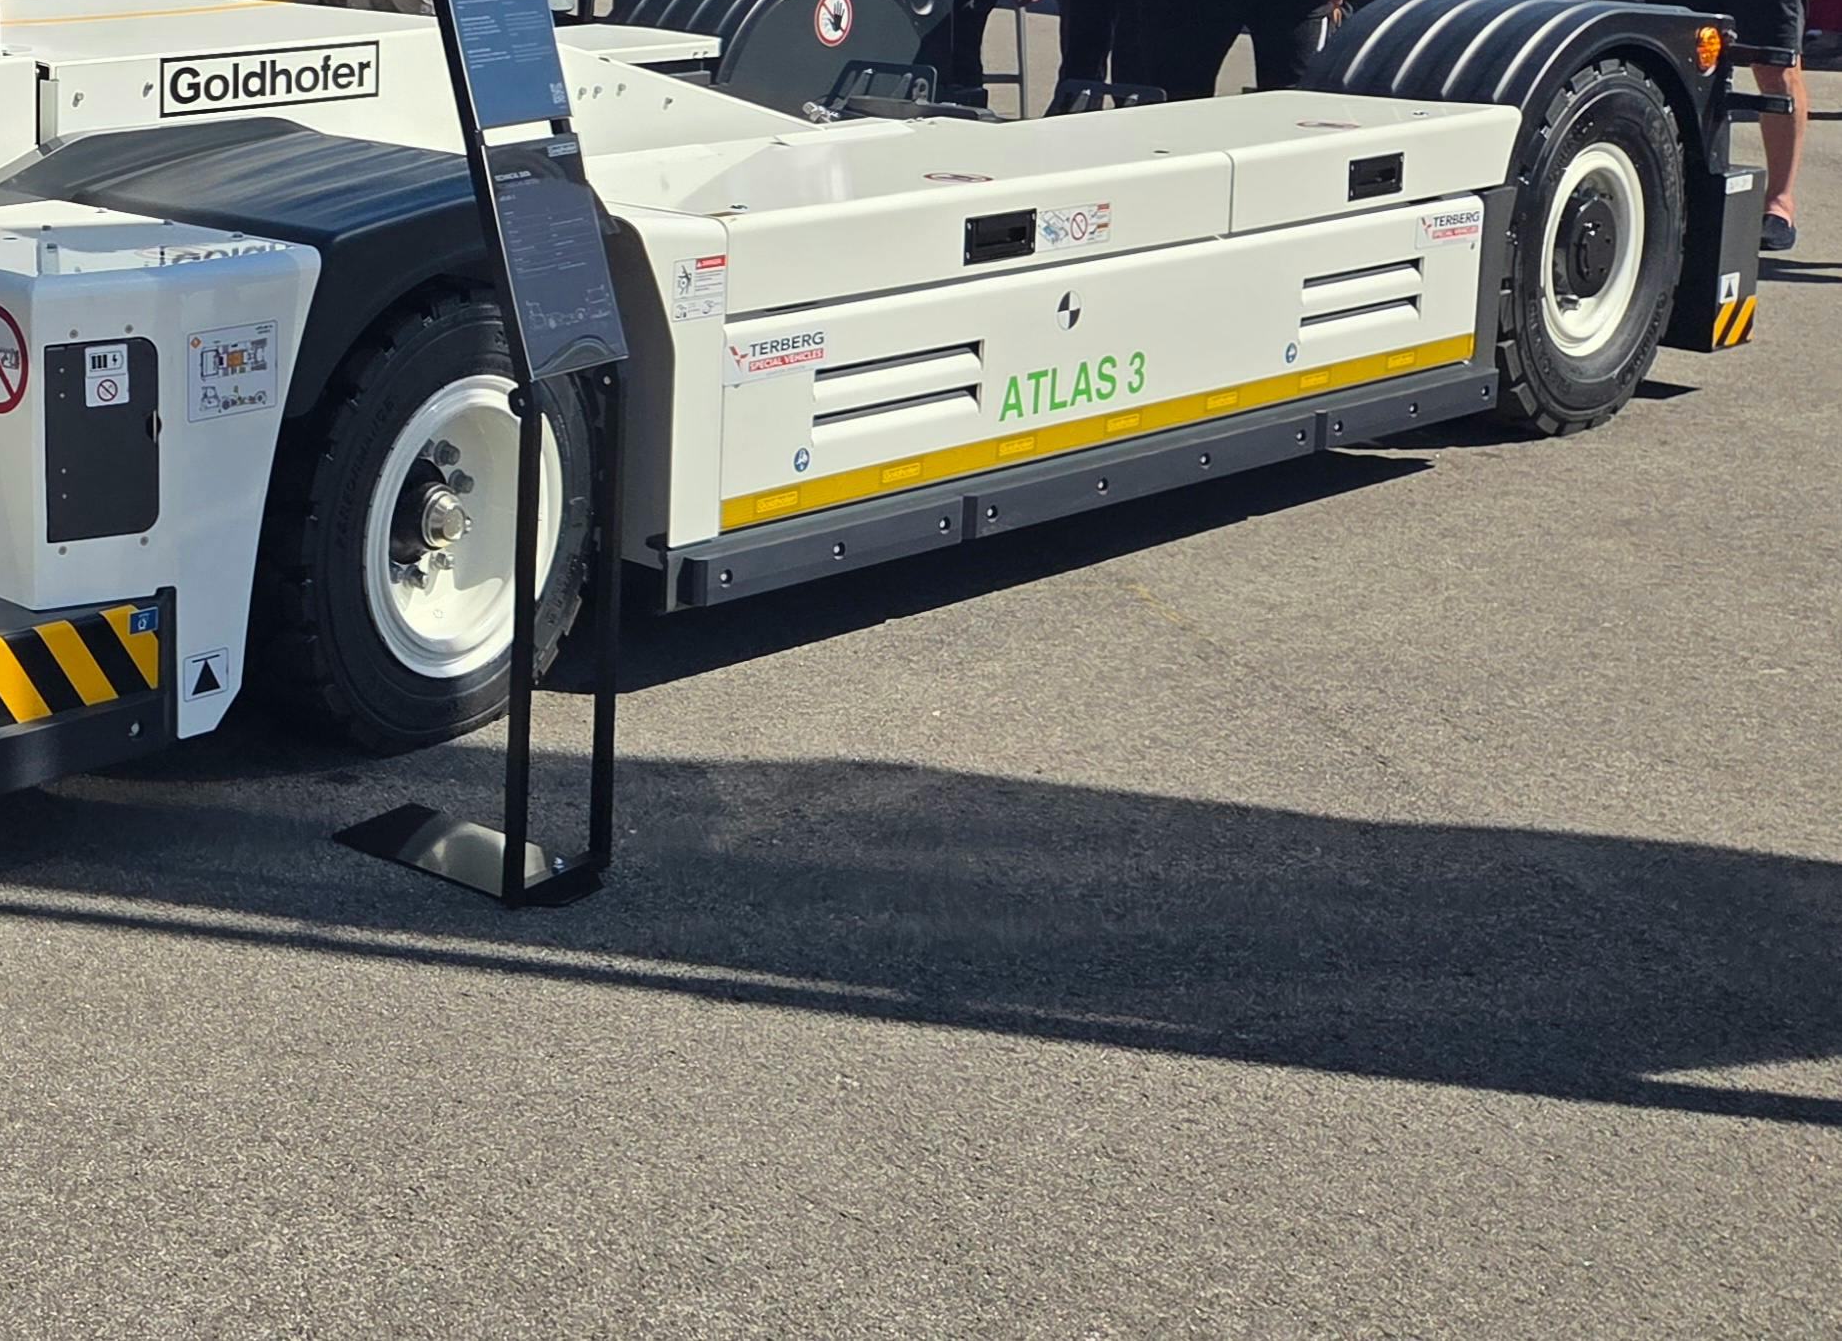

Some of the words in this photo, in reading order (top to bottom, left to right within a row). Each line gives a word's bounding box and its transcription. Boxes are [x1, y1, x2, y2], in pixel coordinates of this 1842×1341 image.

[169, 55, 372, 105] Goldhofer
[1433, 211, 1480, 228] TERBERG
[750, 331, 824, 357] TERBERG
[998, 355, 1118, 422] ATLAS
[1127, 351, 1146, 394] 3
